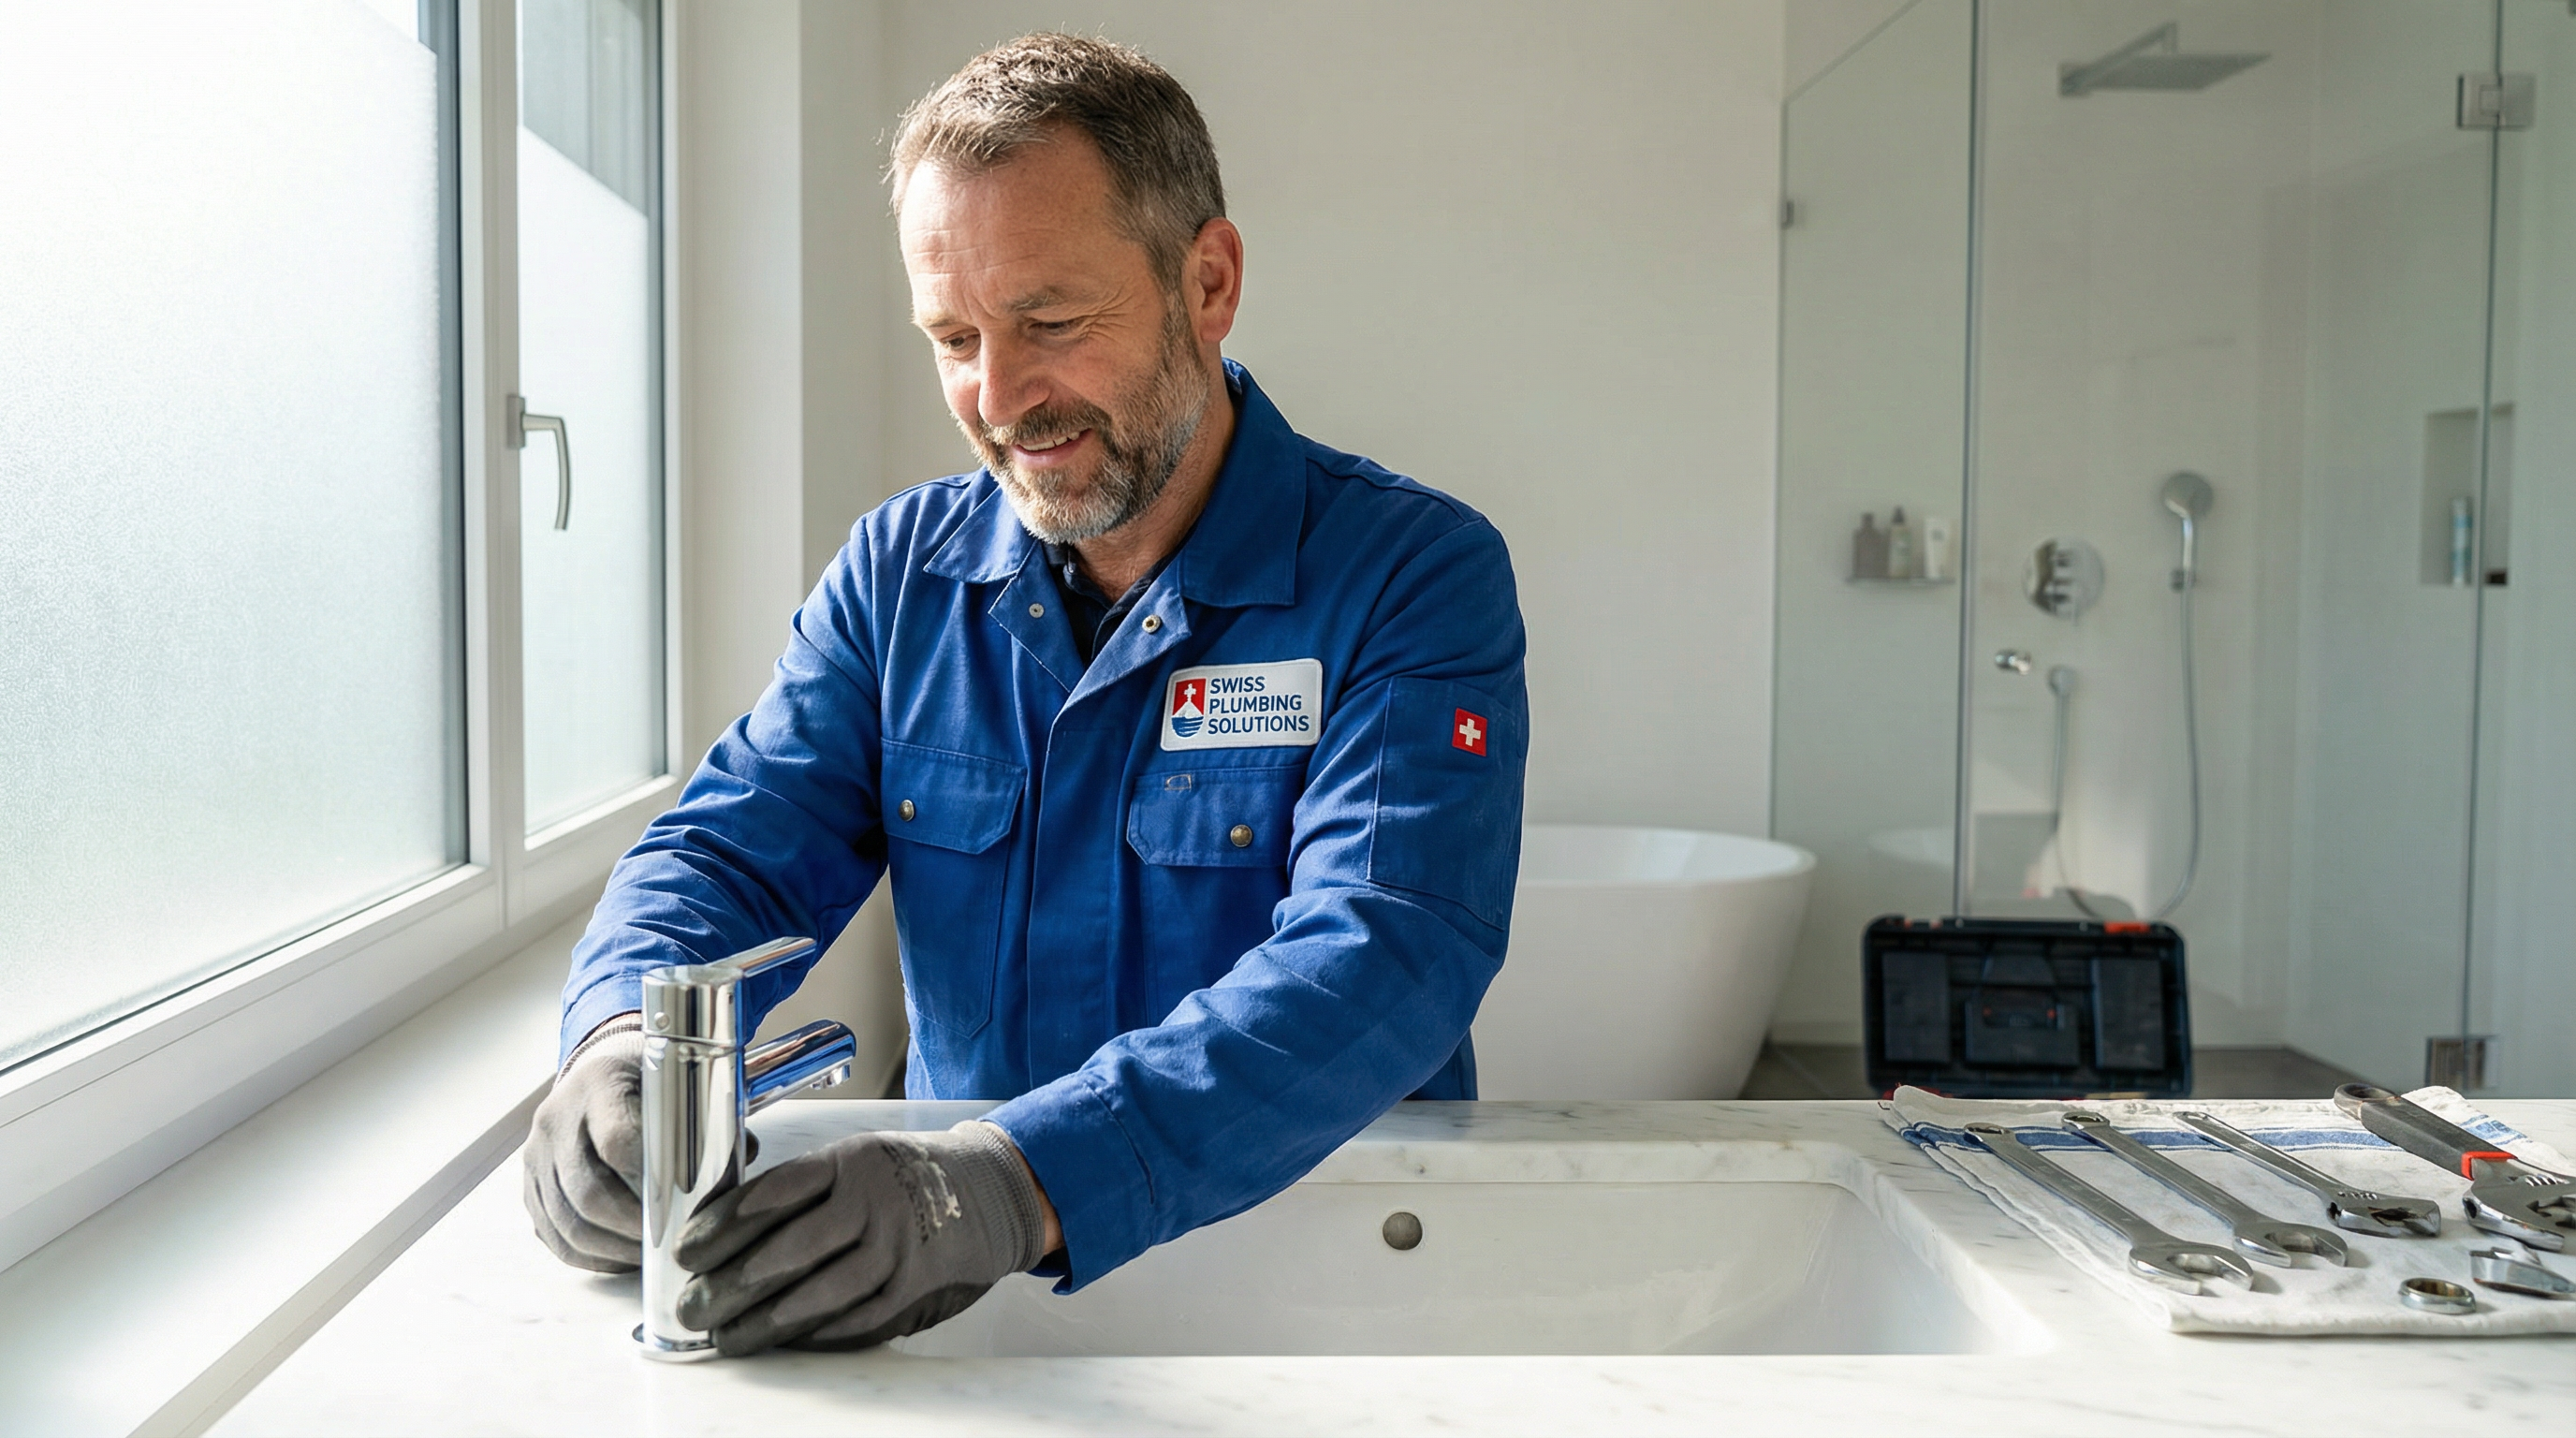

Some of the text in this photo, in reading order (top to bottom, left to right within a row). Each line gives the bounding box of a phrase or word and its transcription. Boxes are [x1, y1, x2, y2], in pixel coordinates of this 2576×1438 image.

[1209, 676, 1266, 694] SWISS
[1208, 695, 1302, 714] PLUMBING
[1208, 715, 1310, 735] SOLUTIONS
